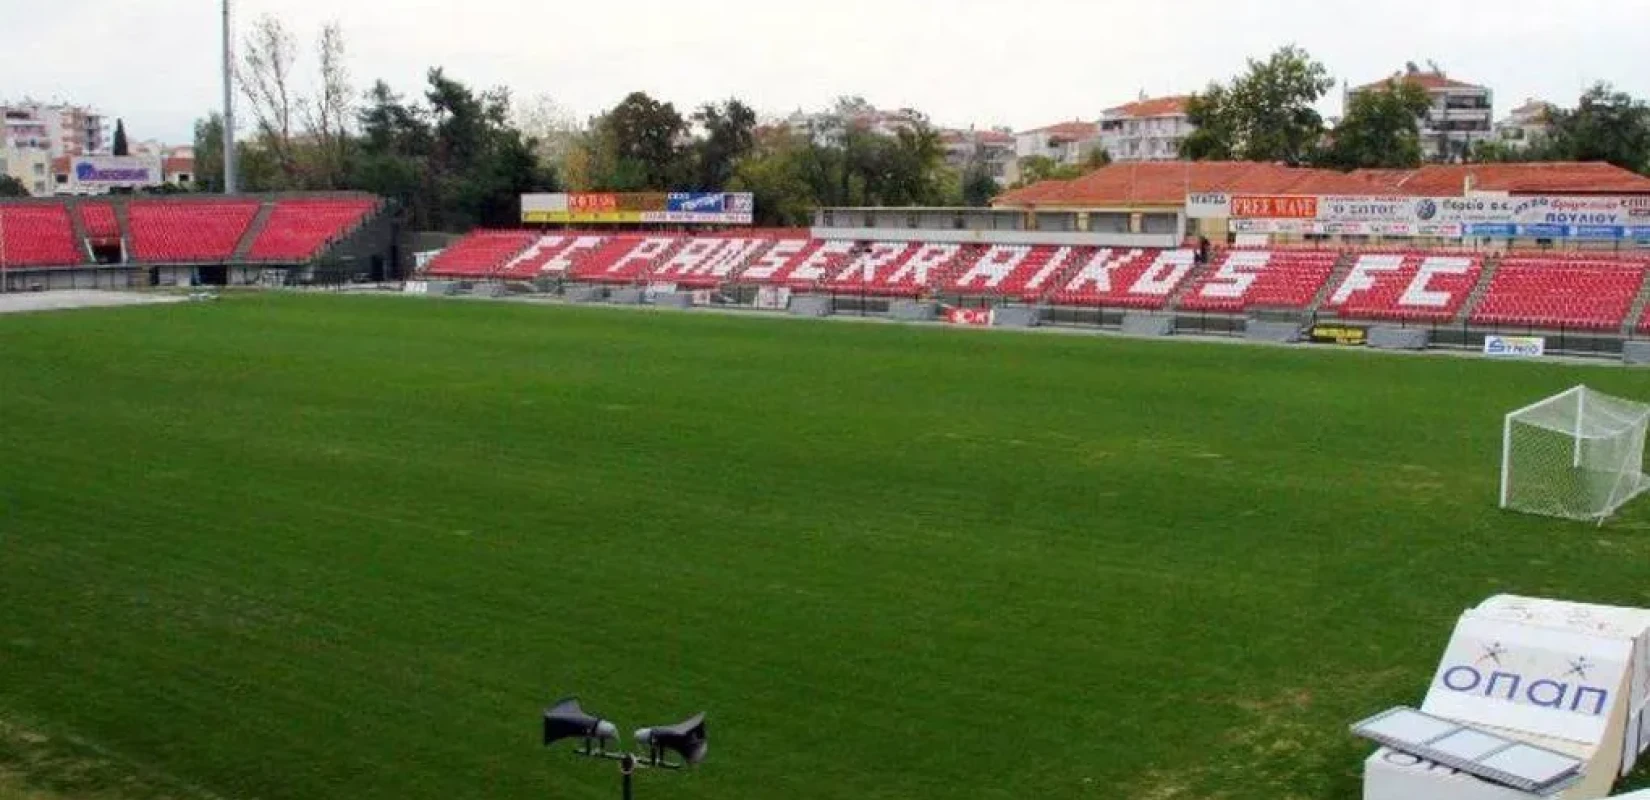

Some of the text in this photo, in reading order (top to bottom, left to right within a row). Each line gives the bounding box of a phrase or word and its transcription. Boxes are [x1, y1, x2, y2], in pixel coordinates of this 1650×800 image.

[1233, 198, 1271, 216] FREE
[1275, 198, 1316, 217] WAVE
[1546, 212, 1617, 224] ΠΟΥΛΙΟΥ
[504, 235, 1474, 307] FC PANSERRAIKOS FC
